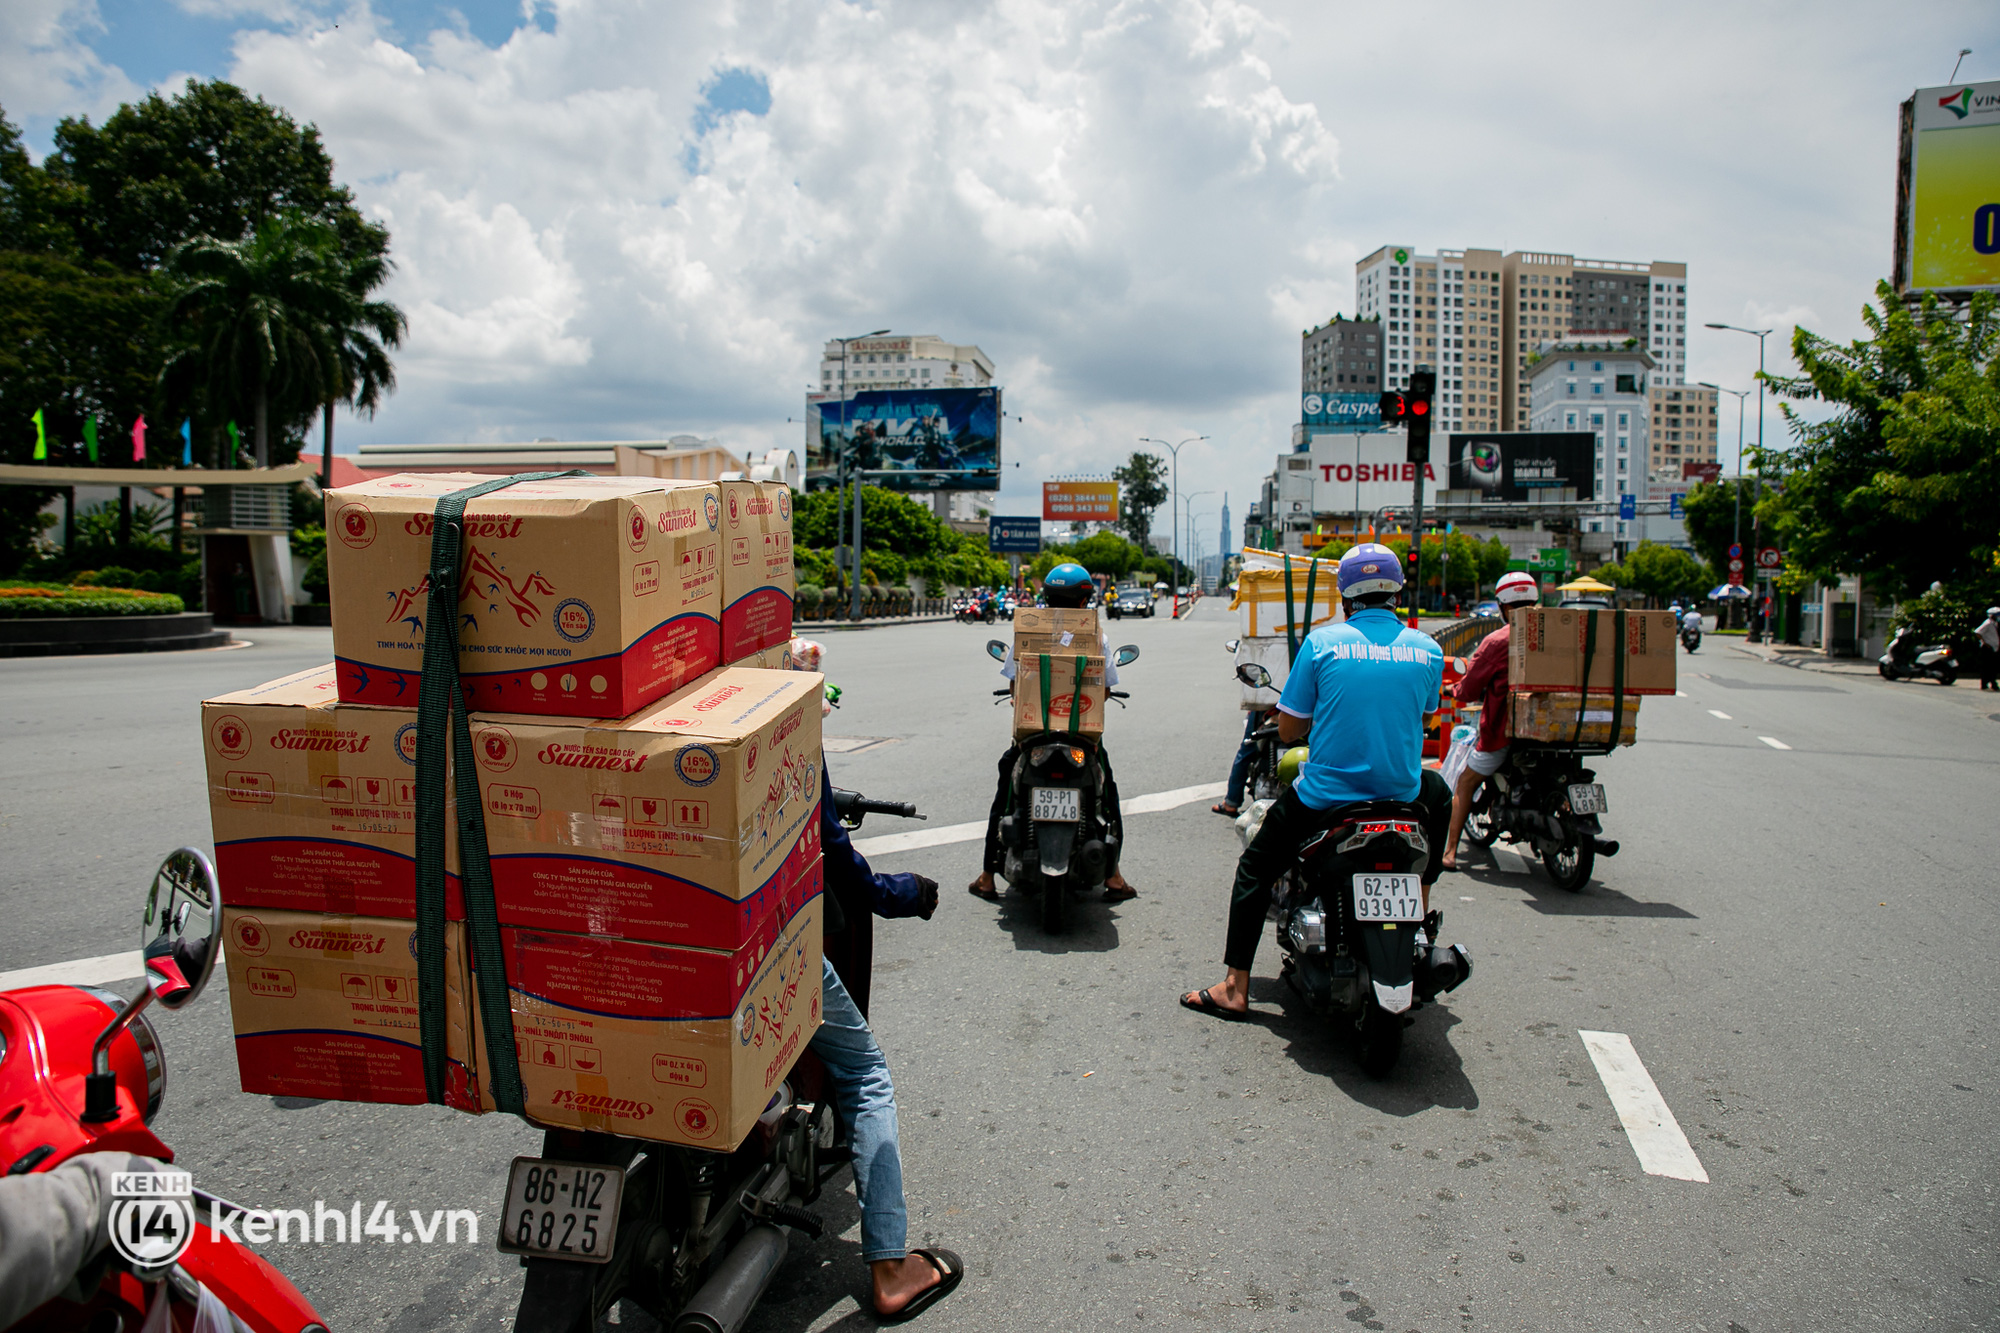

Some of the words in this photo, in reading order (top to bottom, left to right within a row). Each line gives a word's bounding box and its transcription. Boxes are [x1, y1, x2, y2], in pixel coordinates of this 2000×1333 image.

[1326, 400, 1382, 419] Caspe
[1319, 462, 1436, 482] TOSHIBA
[658, 510, 696, 533] Sunnest
[564, 611, 585, 622] 16%
[561, 621, 576, 629] Yến
[377, 641, 395, 649] TINH
[469, 645, 485, 653] CHO
[487, 643, 502, 654] SỨC
[505, 644, 528, 655] KHỎE
[529, 647, 545, 656] MỌI
[547, 647, 571, 657] NGƯỜI
[1334, 641, 1350, 660] SÂN
[1351, 641, 1367, 663] VẬN
[1368, 643, 1391, 664] ĐỘNG
[1392, 644, 1414, 663] QUÂN
[1414, 648, 1427, 665] KHU
[1428, 653, 1432, 667] 7
[270, 729, 370, 753] Sunnest
[564, 744, 580, 752] NƯỚC
[583, 743, 594, 754] YẾN
[595, 746, 607, 755] SÀO
[623, 747, 635, 757] CẤP
[538, 744, 648, 773] Sunnest
[686, 756, 709, 766] 16%
[504, 789, 508, 797] 6
[510, 790, 524, 800] Hộp
[1040, 790, 1071, 804] 59-P1
[330, 808, 354, 818] TRỌNG
[356, 809, 380, 819] LƯỢNG
[382, 810, 400, 820] TỊNH:
[1034, 805, 1077, 819] 887.48
[629, 828, 656, 839] LƯỢNG
[681, 832, 690, 841] 10
[693, 833, 704, 842] KG
[560, 875, 577, 883] TNHH
[578, 877, 599, 885] SX&TM
[1363, 878, 1409, 896] 62-P1
[1359, 899, 1418, 917] 939.17
[289, 930, 386, 954] Sunnest
[351, 1002, 374, 1012] TRỌNG
[376, 1004, 399, 1014] LƯỢNG
[401, 1005, 419, 1015] TỊNH:
[523, 1026, 541, 1037] TỊNH:
[544, 1028, 567, 1040] LƯỢNG
[569, 1032, 593, 1044] TRỌNG
[684, 1074, 689, 1083] 6
[550, 1090, 654, 1120] Sunnest
[516, 1211, 598, 1253] 6825
